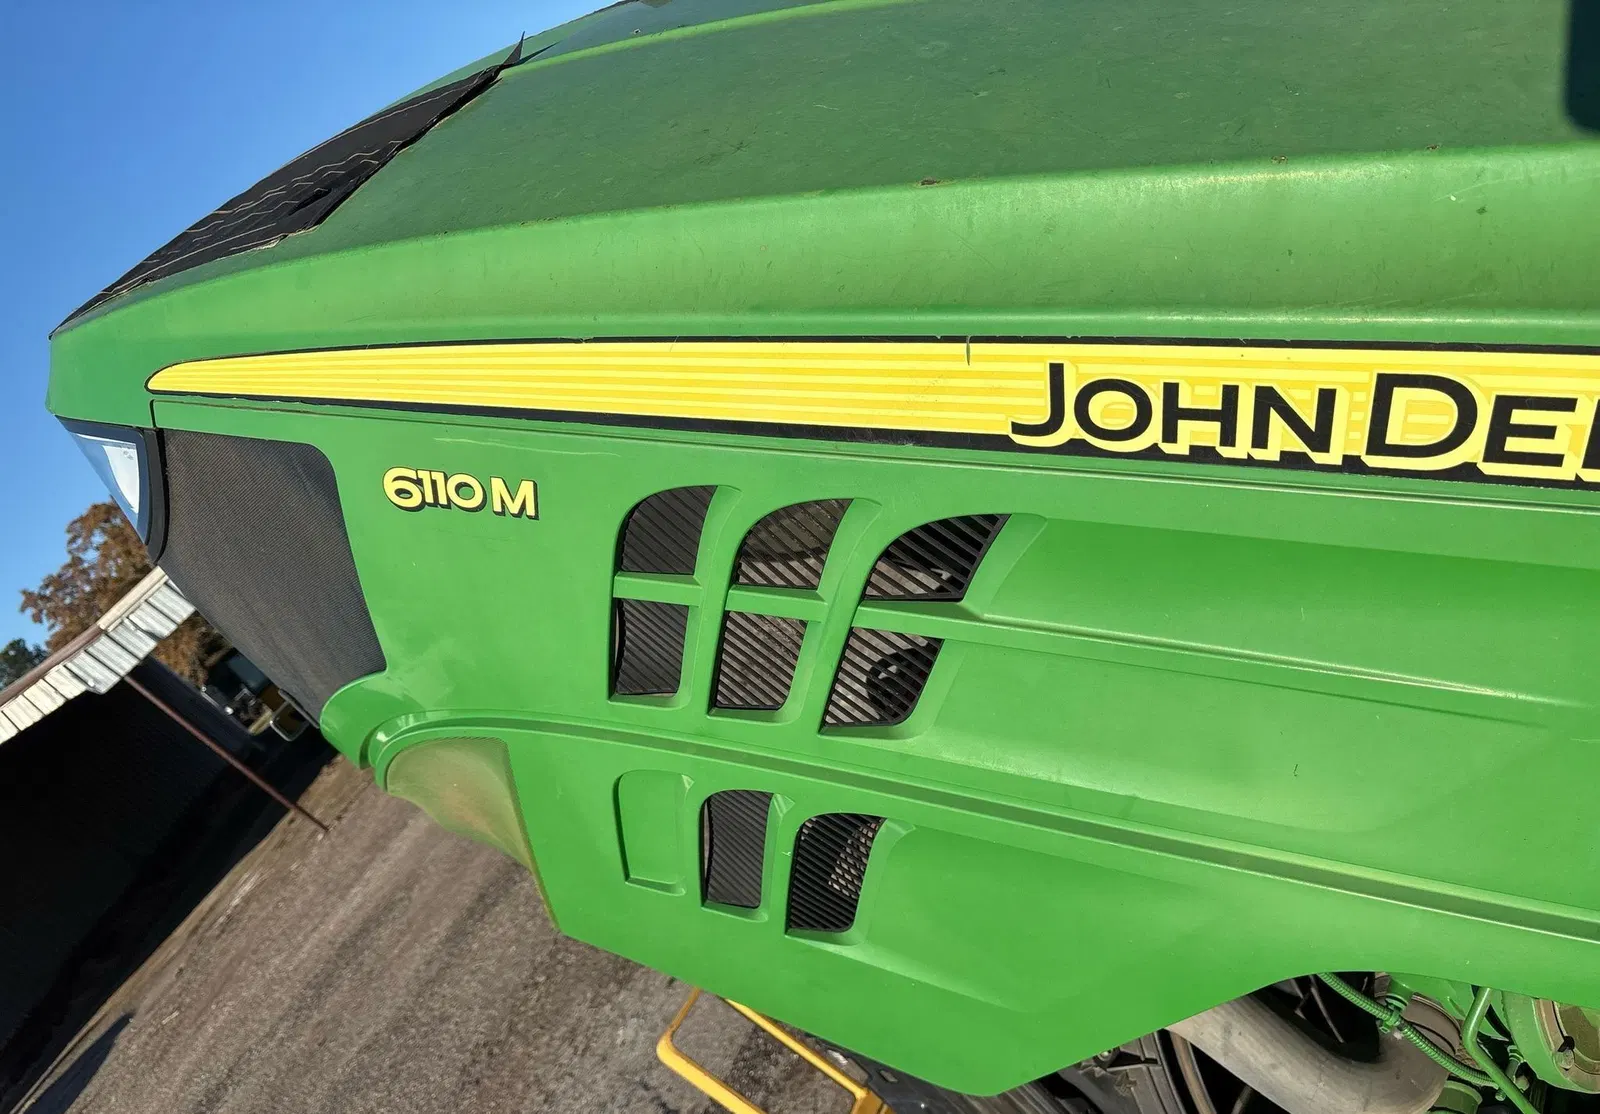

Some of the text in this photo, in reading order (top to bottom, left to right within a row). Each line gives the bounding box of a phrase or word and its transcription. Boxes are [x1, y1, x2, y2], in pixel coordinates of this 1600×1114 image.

[1010, 362, 1600, 470] JOHN DE
[383, 466, 539, 520] 6110 M
